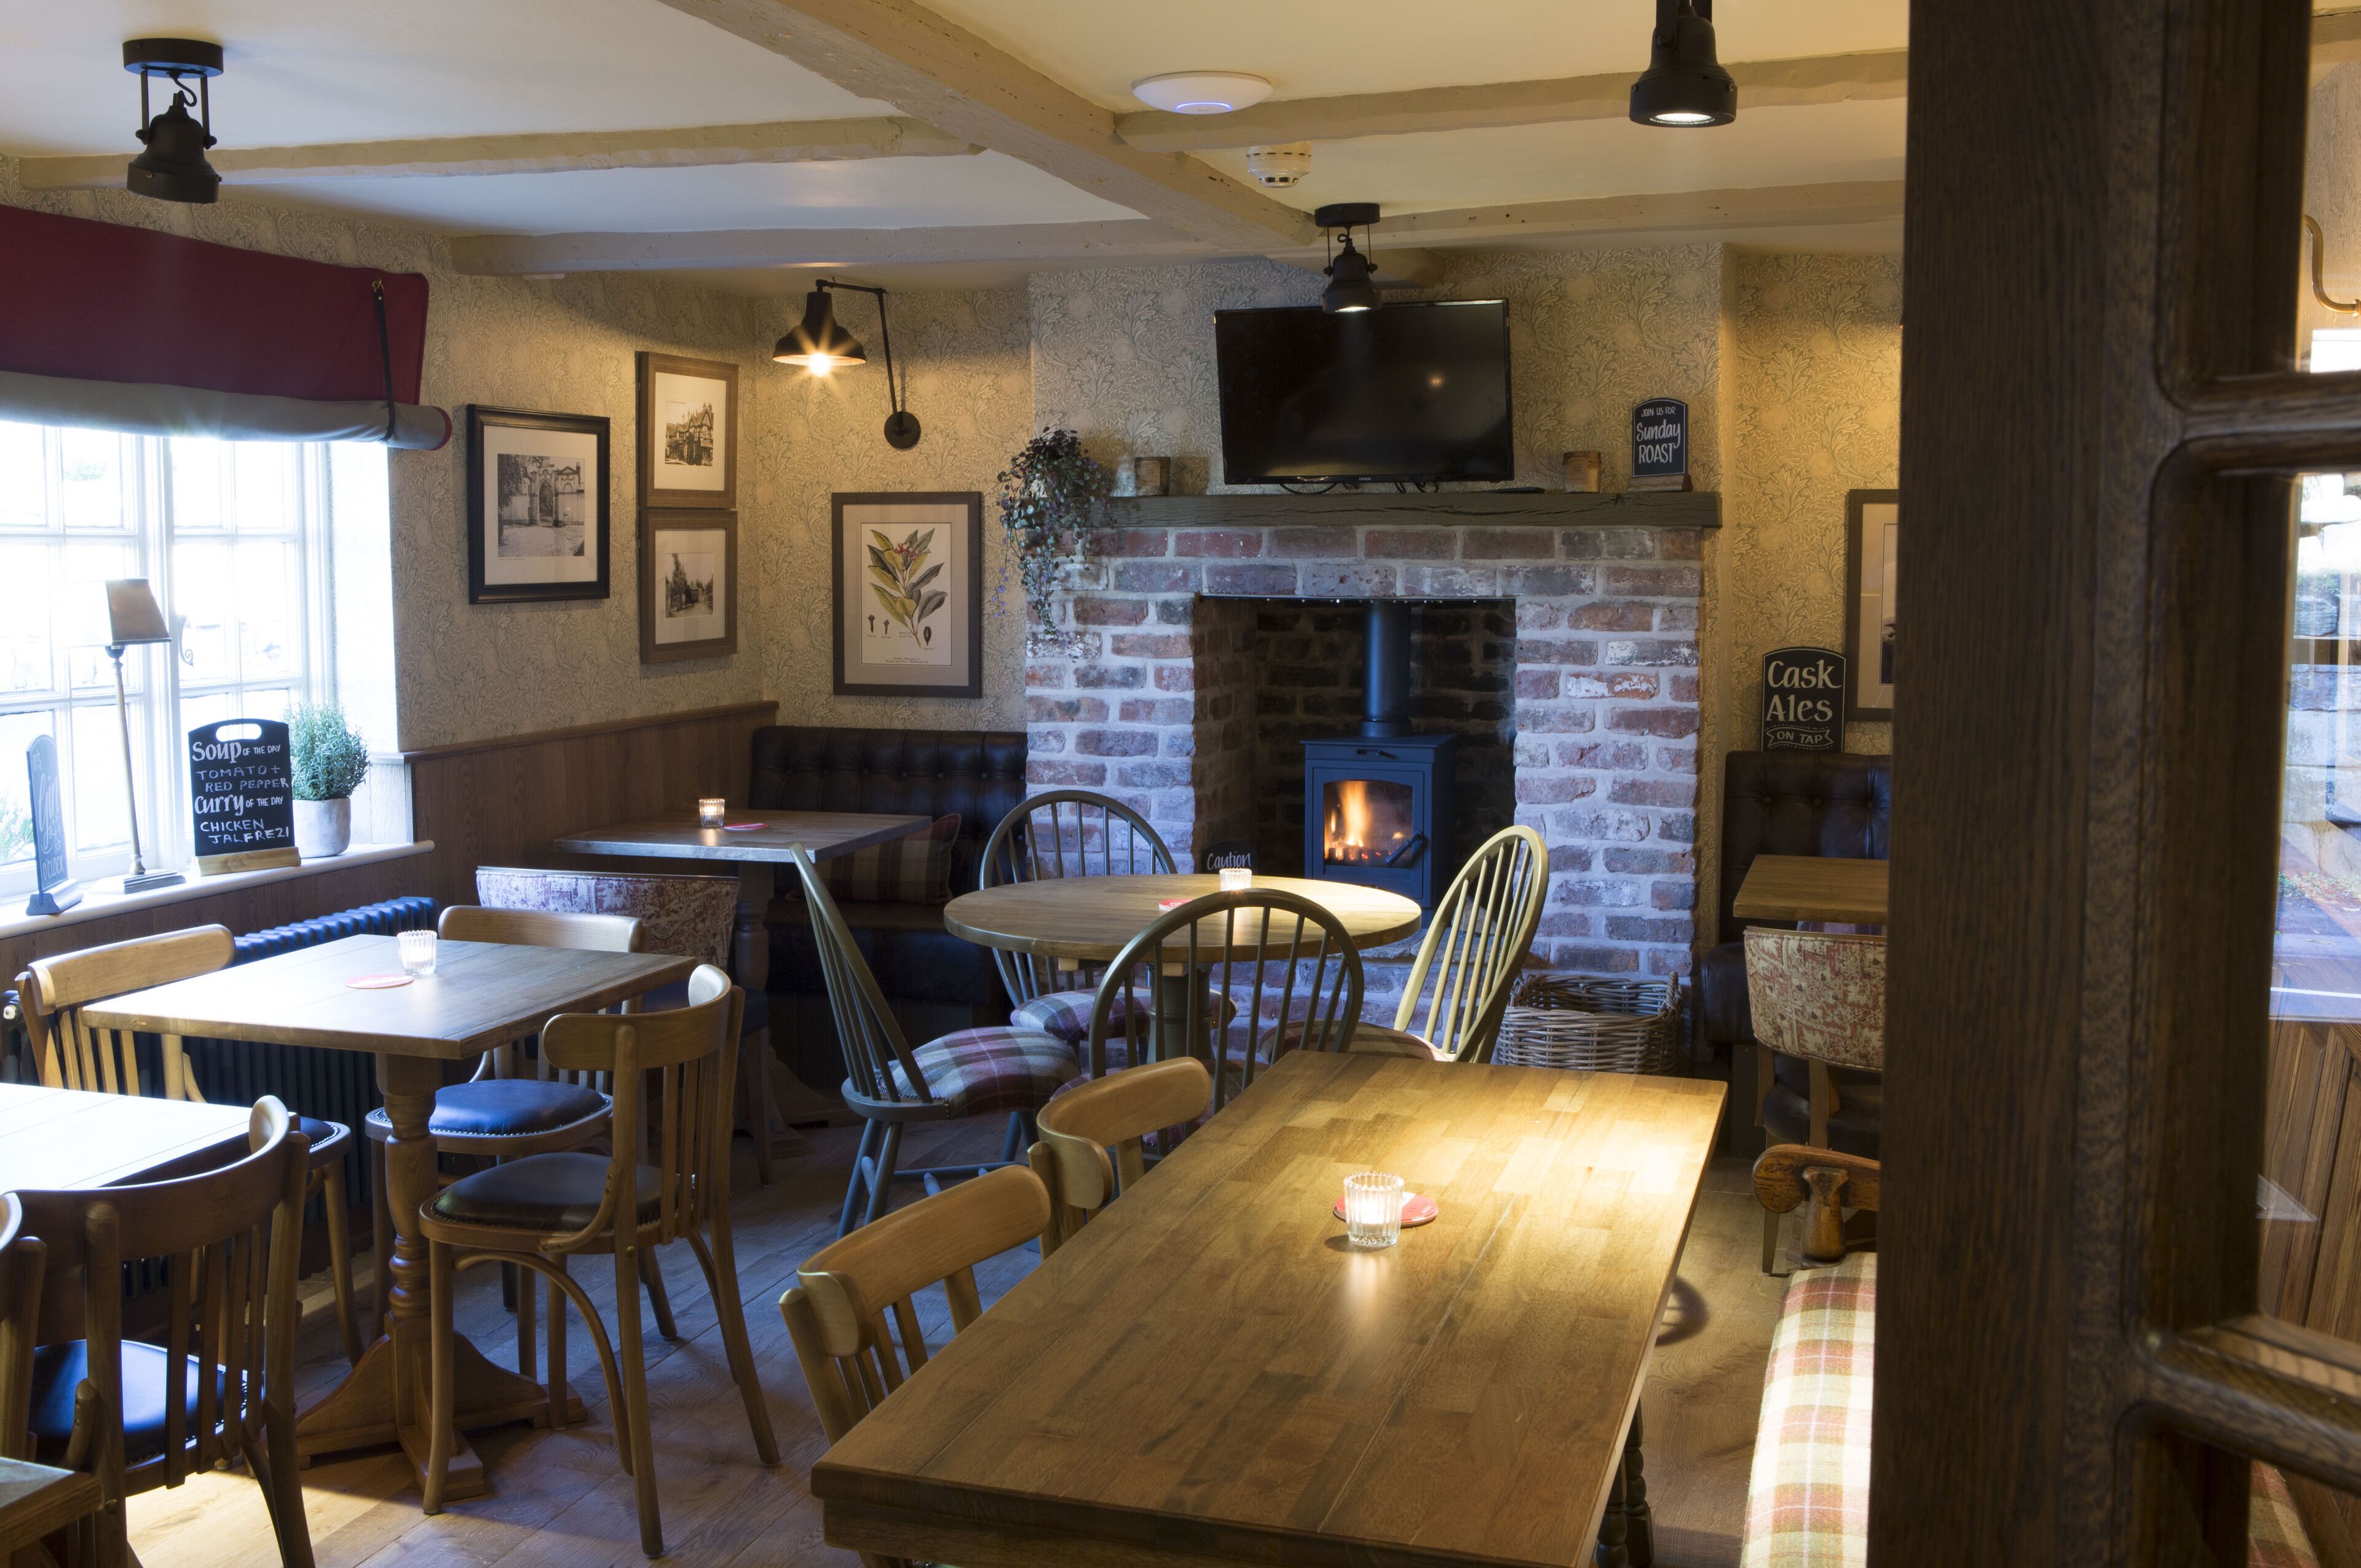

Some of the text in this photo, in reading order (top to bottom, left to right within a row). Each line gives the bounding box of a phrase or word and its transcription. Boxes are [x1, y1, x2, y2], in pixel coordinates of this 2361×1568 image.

[1641, 408, 1654, 418] JOIN
[1656, 407, 1664, 416] US
[1636, 419, 1681, 449] Sunday
[1639, 443, 1675, 464] ROAST
[1768, 659, 1842, 689] Cask
[1766, 695, 1833, 722] Ales
[1776, 731, 1823, 744] ON TAP
[192, 741, 242, 764] Soup
[243, 748, 250, 756] OF
[253, 746, 265, 754] THE
[196, 766, 267, 780] TOMATO
[205, 778, 289, 793] RED PEPPER
[194, 794, 283, 816] Curry OF THE DAY
[200, 818, 264, 832] CHICKEN
[208, 826, 289, 844] JALFREZI
[1207, 851, 1252, 871] Caution
